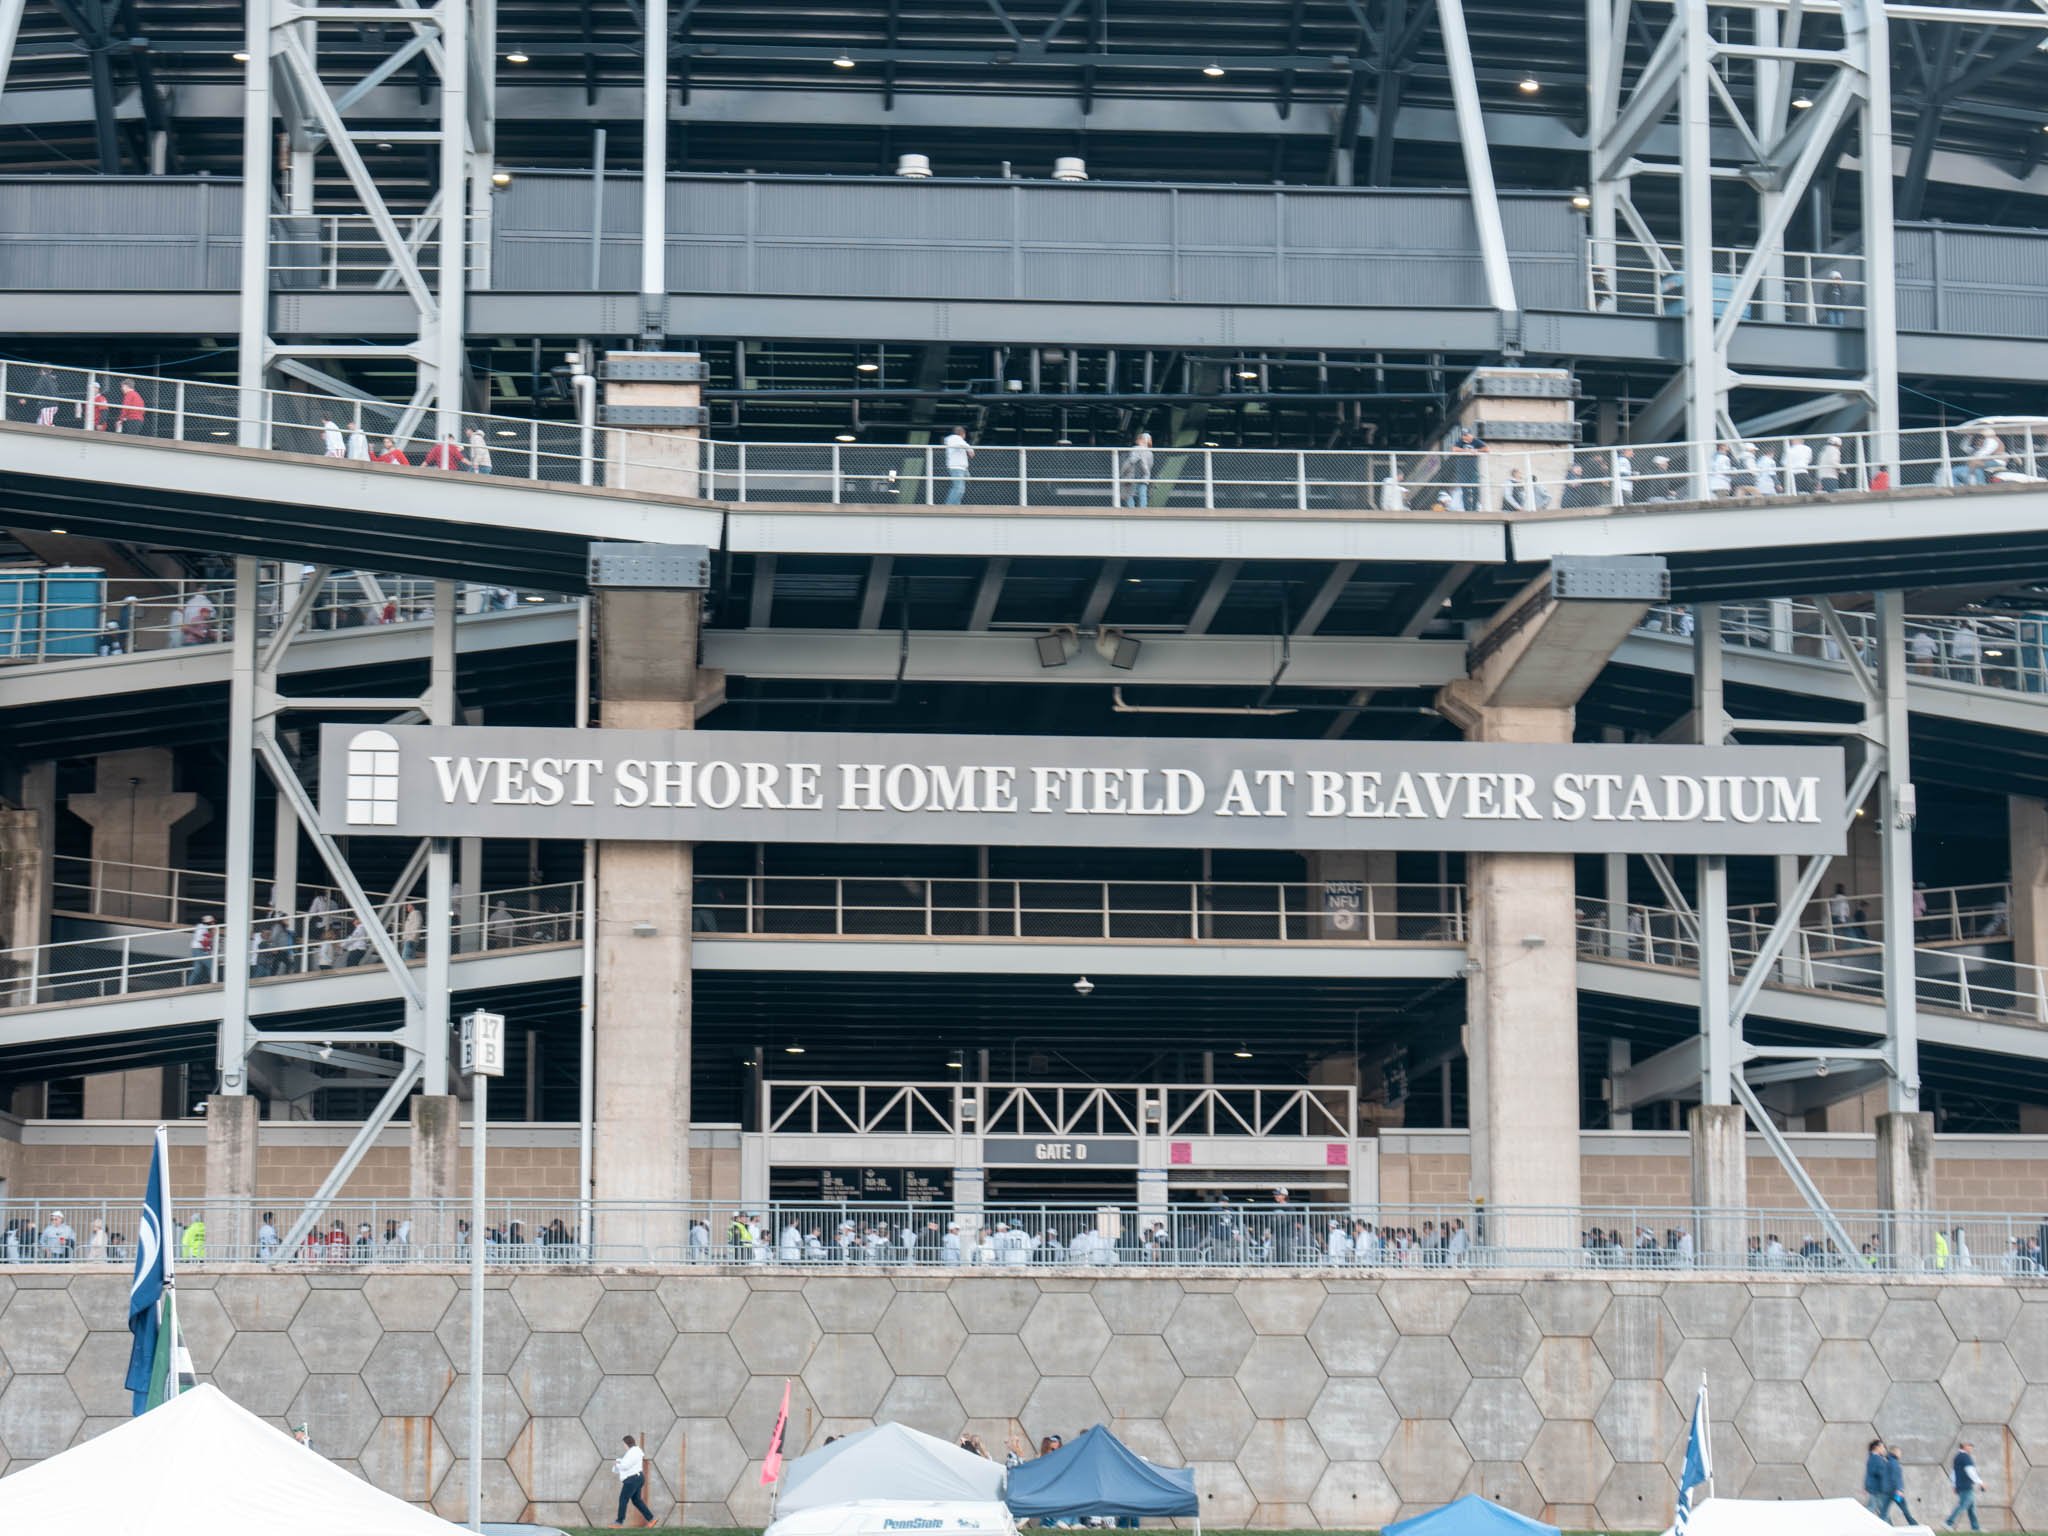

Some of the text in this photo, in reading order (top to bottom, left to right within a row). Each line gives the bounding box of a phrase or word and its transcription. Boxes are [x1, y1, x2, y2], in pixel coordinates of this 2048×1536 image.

[429, 756, 1822, 824] WEST SHORE HOME FIELD AT BEAVER STADIUM
[482, 1018, 499, 1040] 17
[466, 1043, 473, 1065] B
[485, 1043, 496, 1064] B
[1035, 1143, 1087, 1160] GATE D
[883, 1518, 943, 1530] PennState
